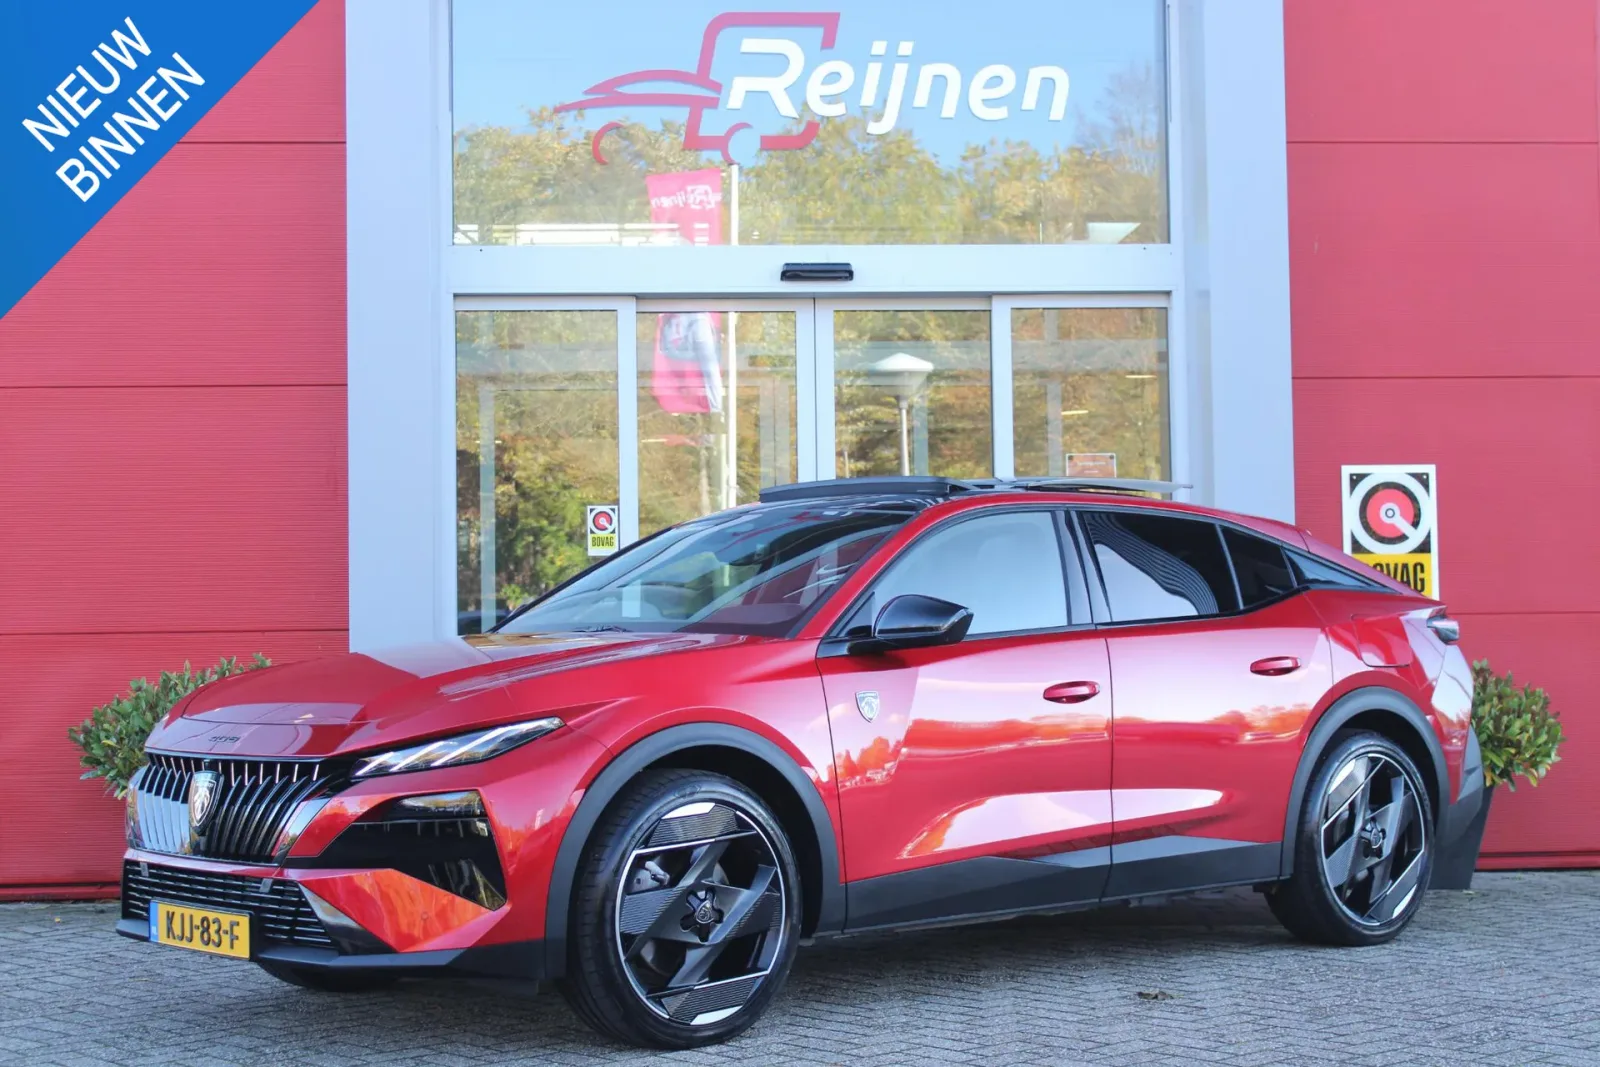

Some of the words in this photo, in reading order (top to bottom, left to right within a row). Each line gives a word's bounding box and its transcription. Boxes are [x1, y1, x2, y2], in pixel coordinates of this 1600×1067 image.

[726, 38, 1070, 135] Reijnen
[591, 536, 614, 547] BOVAG
[1372, 562, 1425, 593] VAG
[166, 910, 240, 950] KJJ-83-F
